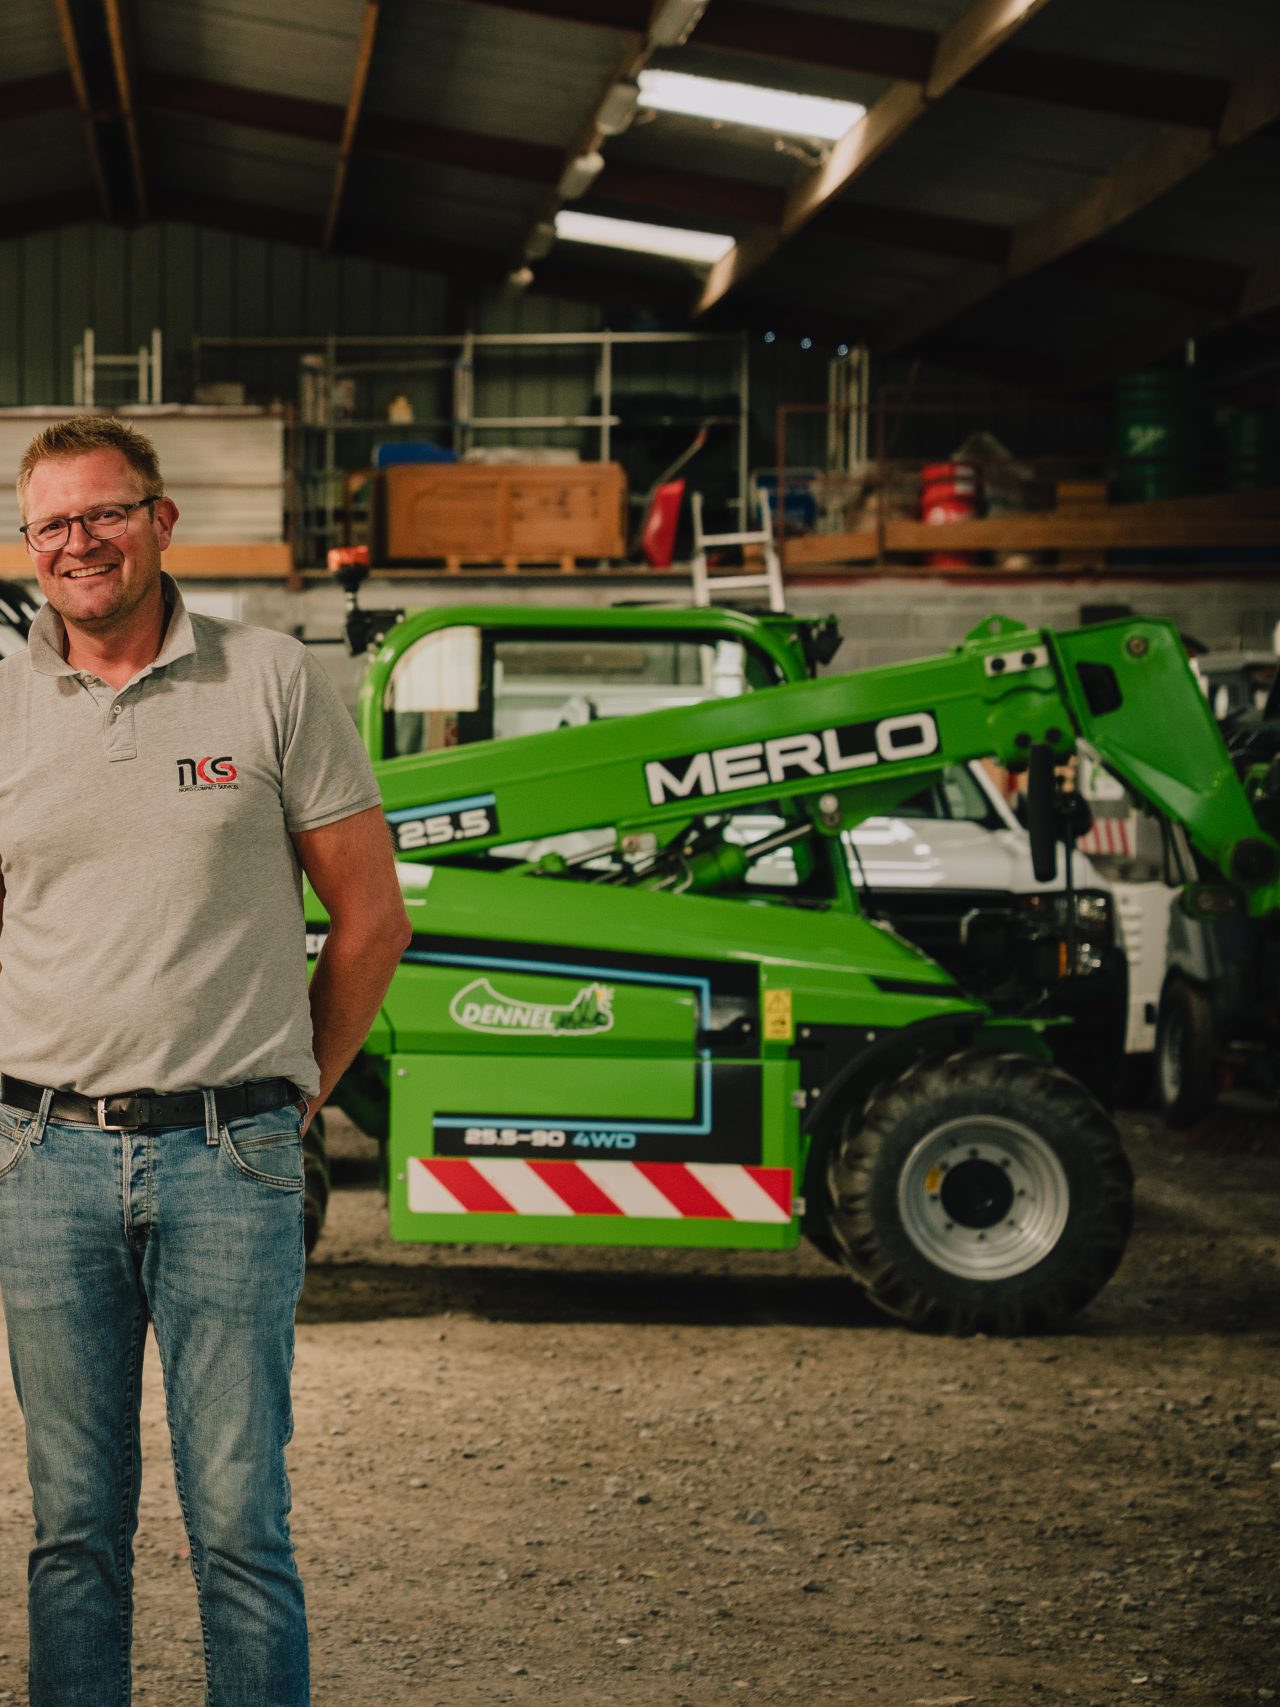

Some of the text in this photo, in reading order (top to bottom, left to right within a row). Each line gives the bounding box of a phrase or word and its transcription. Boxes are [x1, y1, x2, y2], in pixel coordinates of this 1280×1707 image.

[645, 712, 939, 805] MERLO
[397, 808, 490, 849] 25.5
[462, 1002, 555, 1029] DENNEL
[572, 1131, 637, 1149] 4WD
